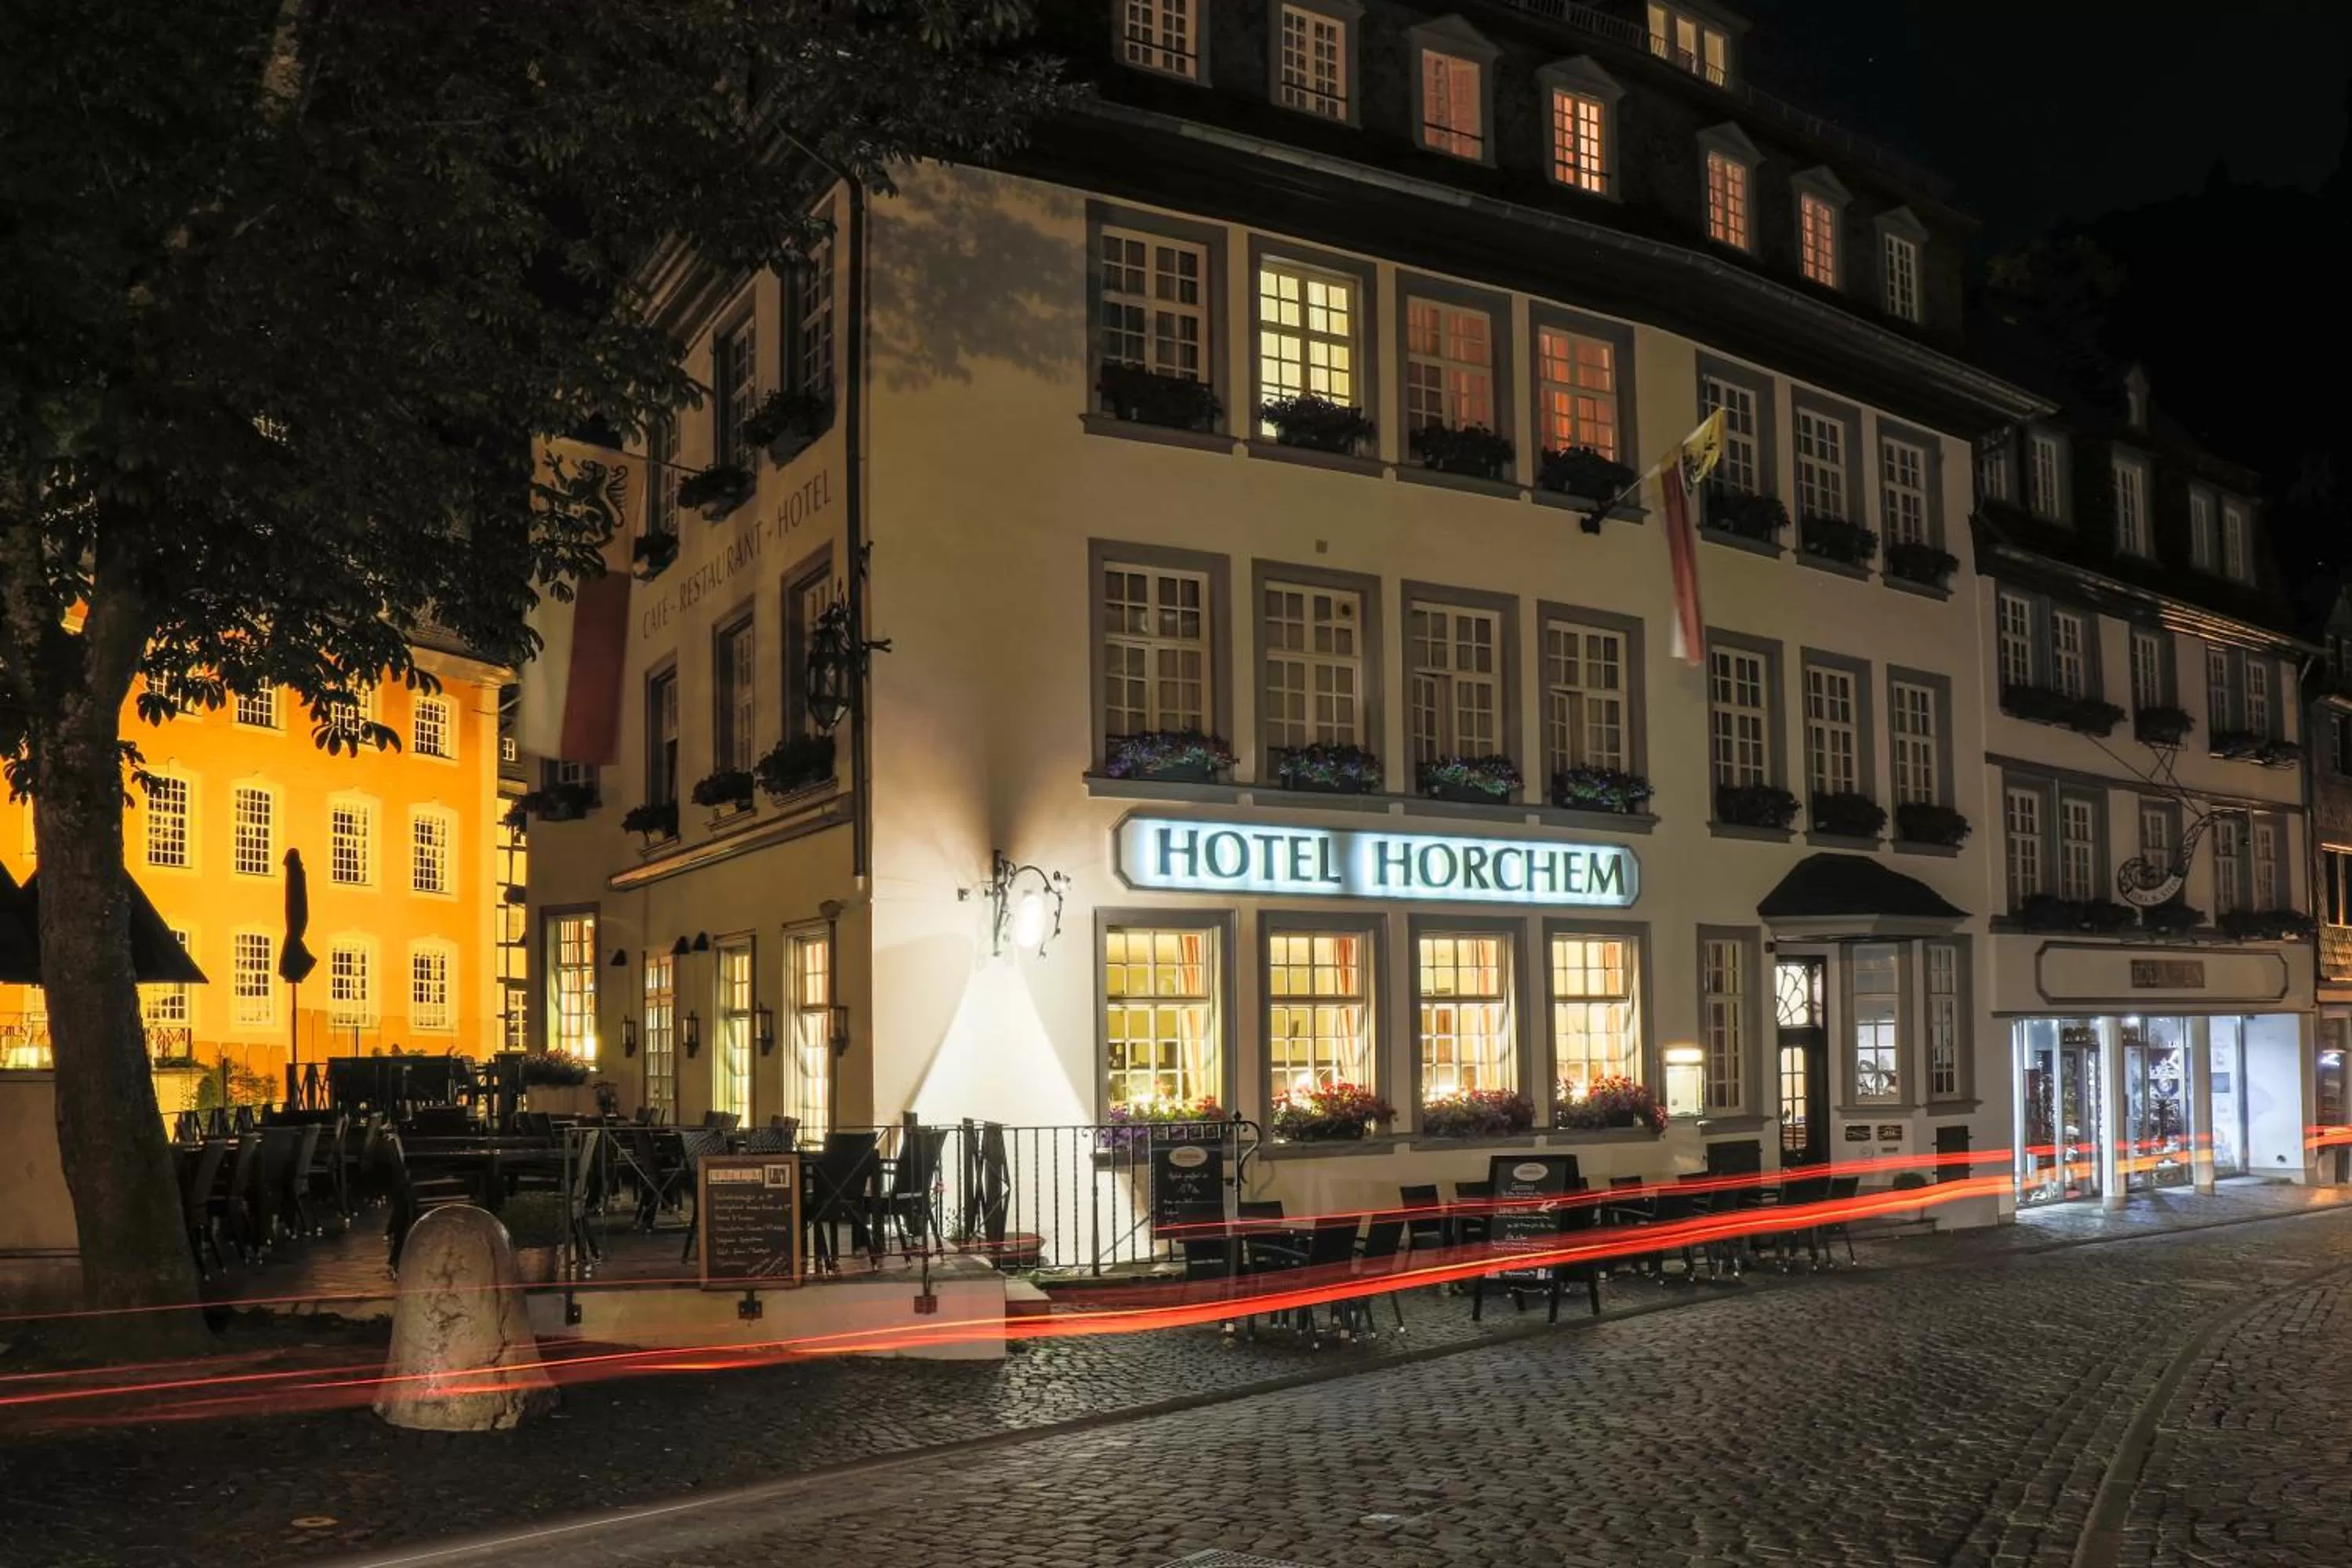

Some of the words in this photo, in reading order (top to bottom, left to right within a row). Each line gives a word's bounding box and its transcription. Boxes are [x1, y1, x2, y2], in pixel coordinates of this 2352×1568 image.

[679, 520, 763, 612] RESTAURANT
[777, 469, 831, 539] HOTEL
[1155, 827, 1341, 884] HOTEL
[1372, 840, 1626, 896] HORCHEM
